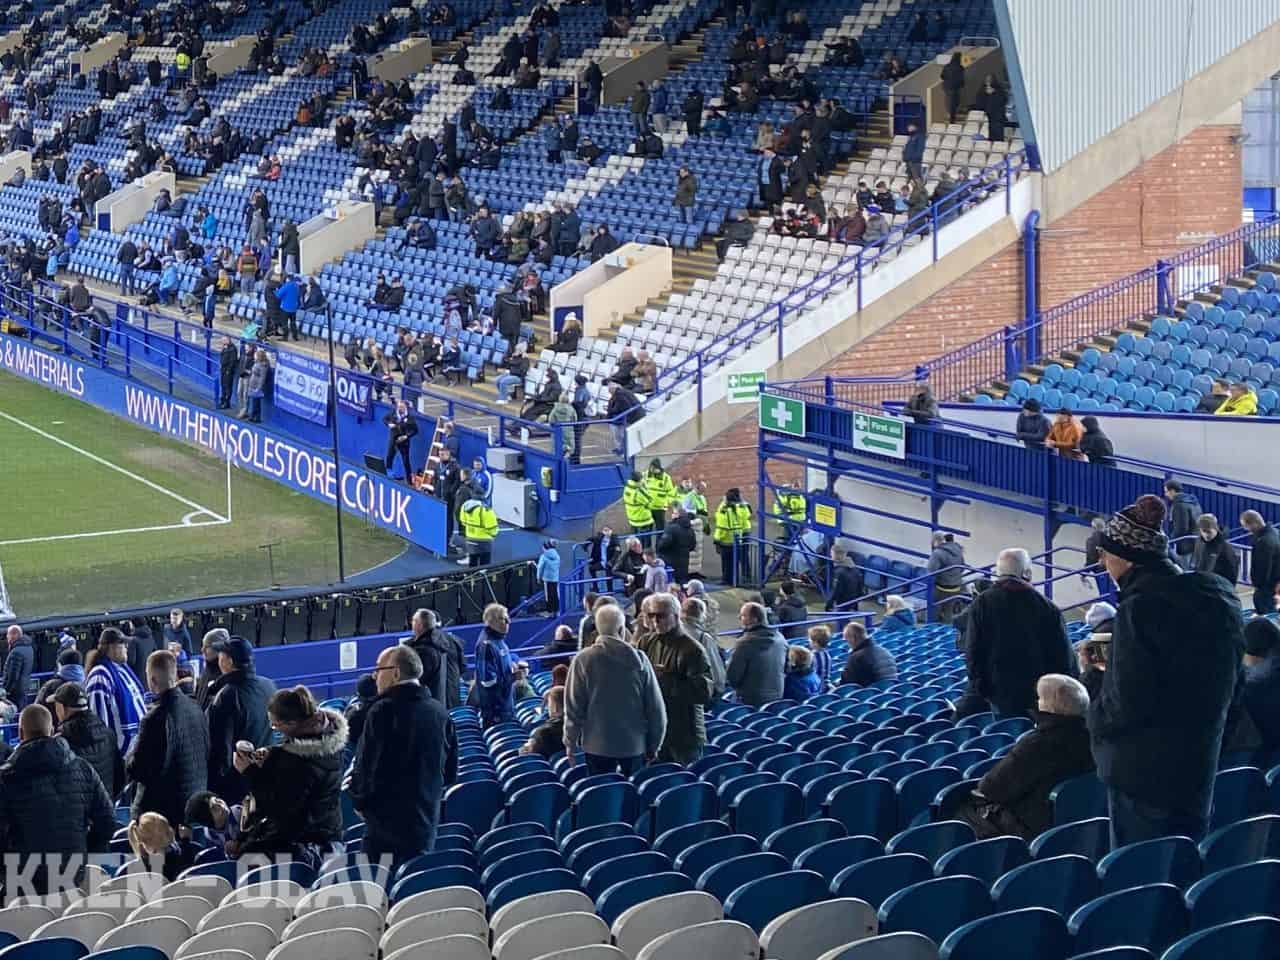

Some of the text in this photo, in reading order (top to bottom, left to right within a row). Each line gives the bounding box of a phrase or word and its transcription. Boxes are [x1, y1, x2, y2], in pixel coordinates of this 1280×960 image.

[4, 342, 14, 368] &
[15, 343, 84, 396] MATERIALS
[124, 385, 412, 533] WWW.THEINSOLESTORECO.UK
